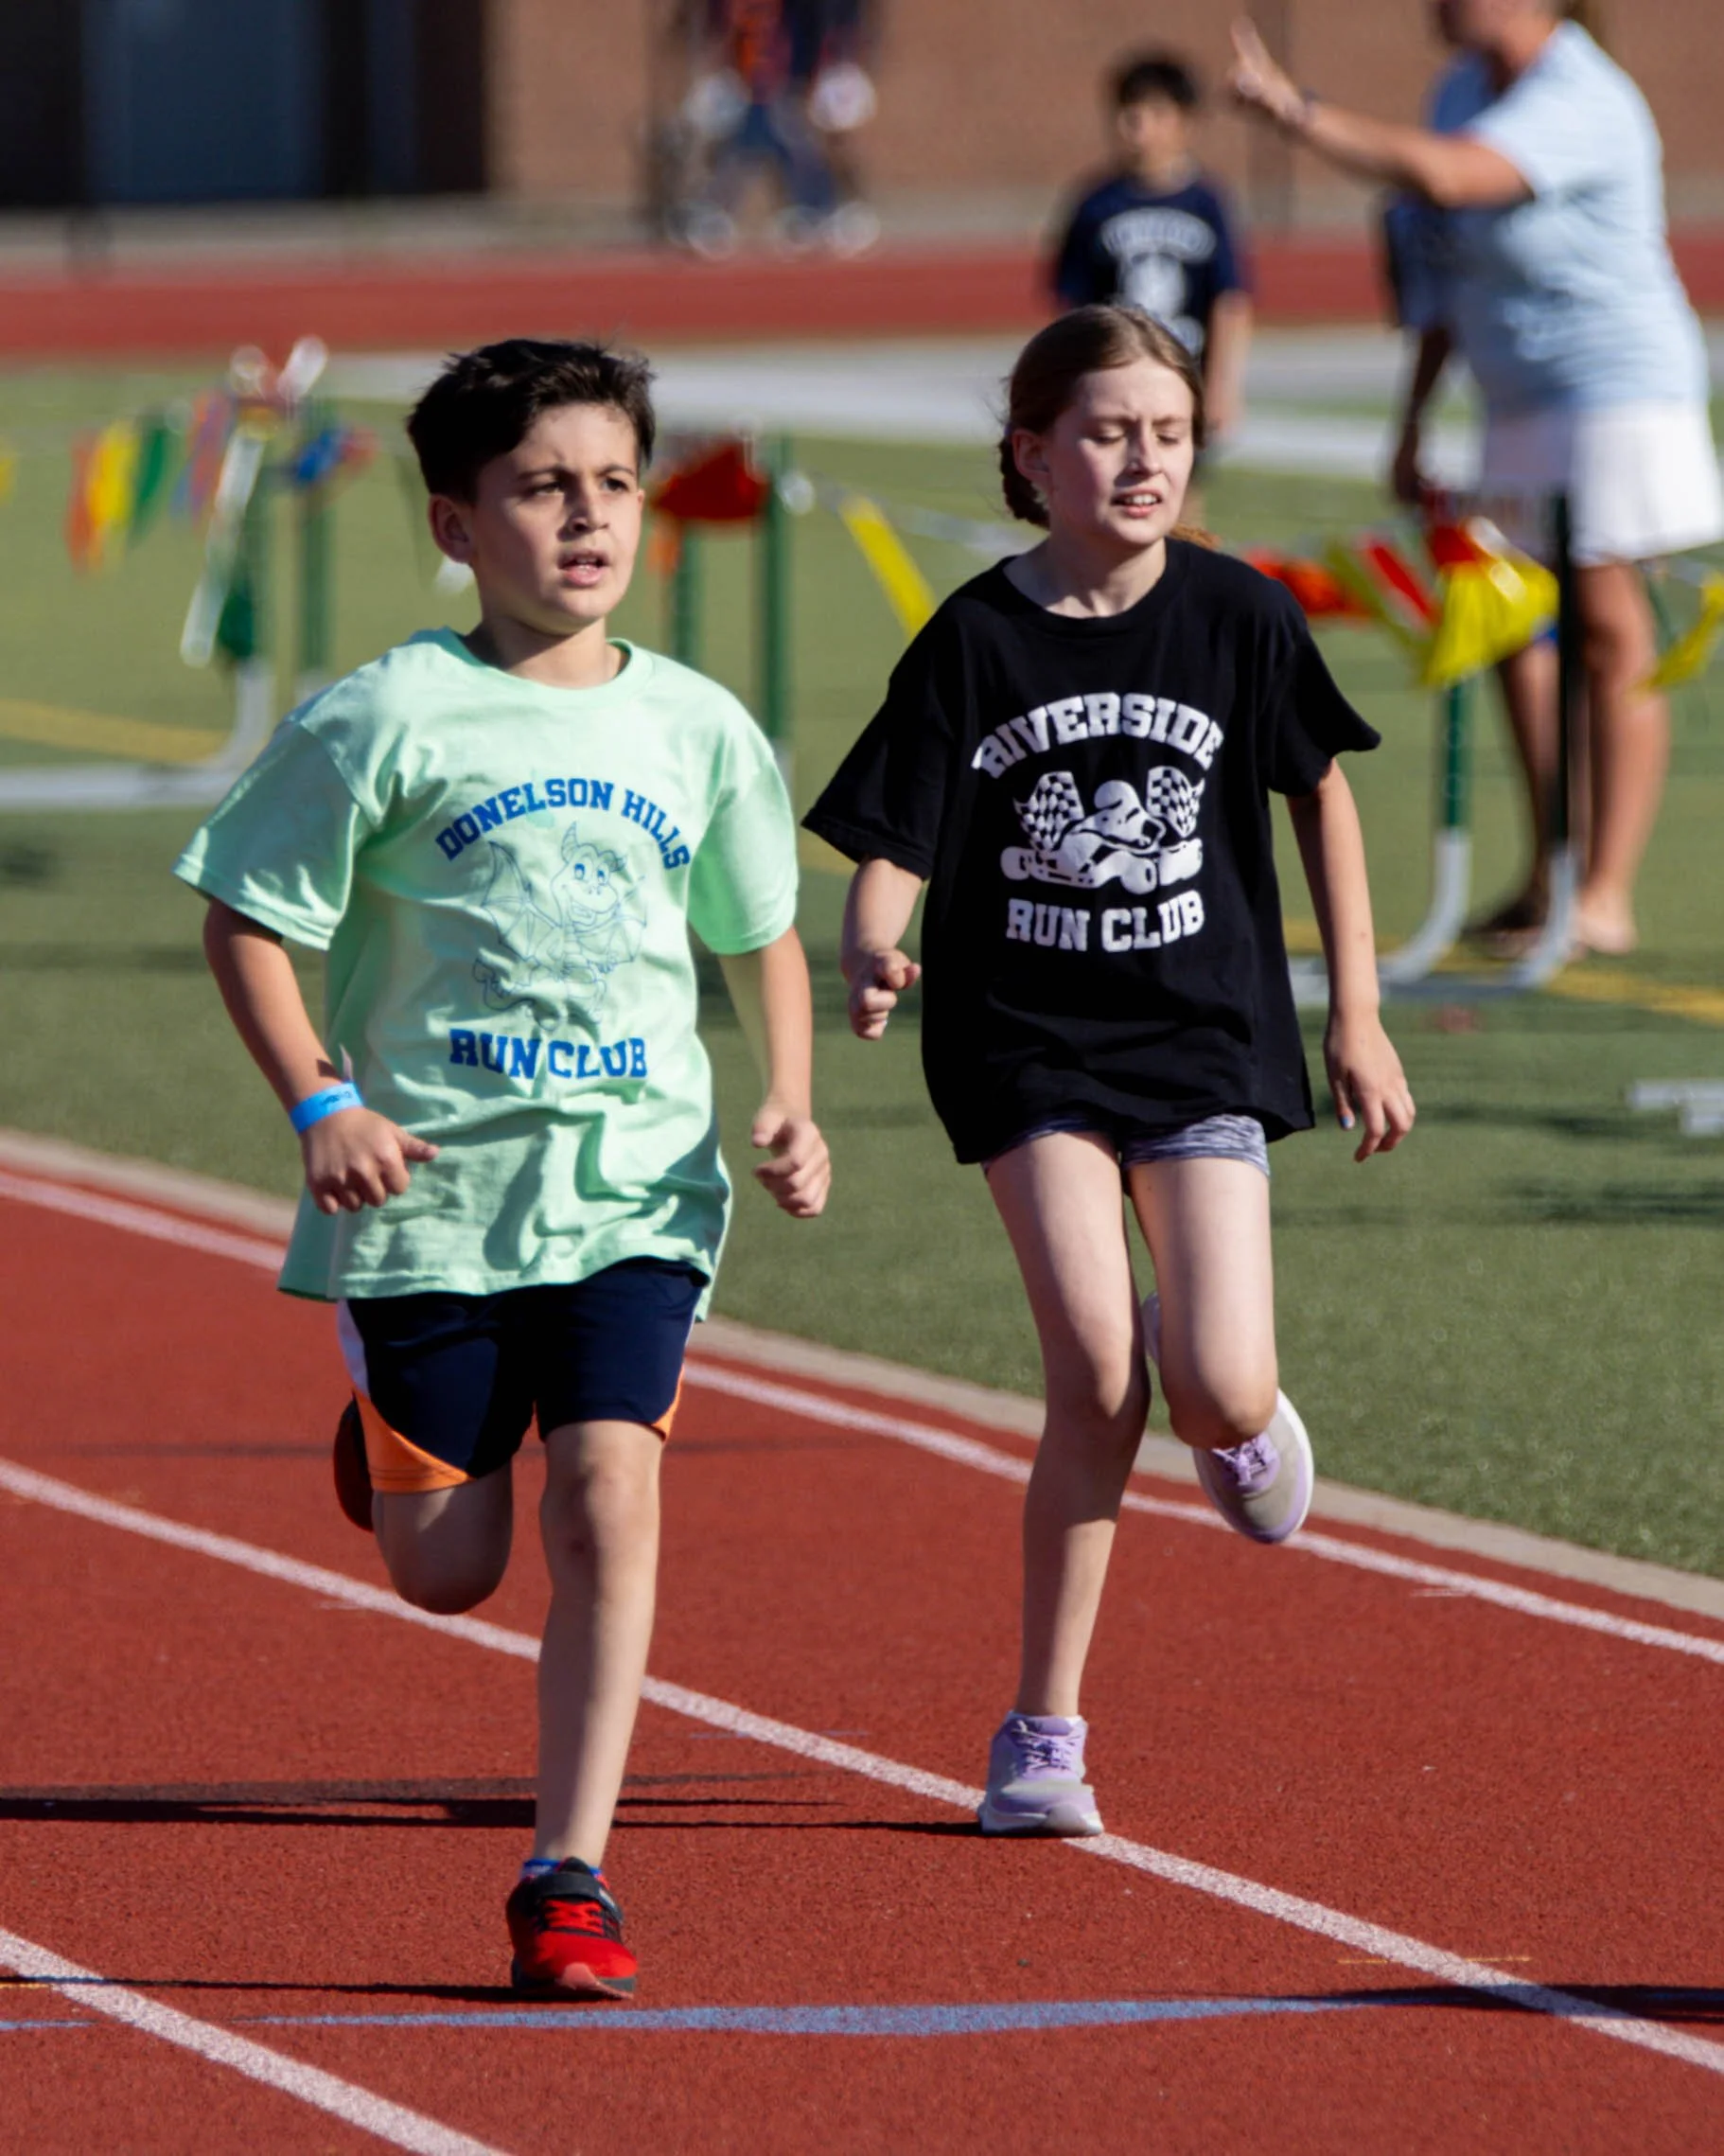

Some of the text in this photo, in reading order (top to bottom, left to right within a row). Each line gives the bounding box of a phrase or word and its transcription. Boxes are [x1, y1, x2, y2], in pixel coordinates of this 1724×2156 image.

[971, 692, 1224, 779] RIVERSIDE
[435, 778, 691, 870] DONELSON HILLS
[1006, 890, 1205, 952] RUN CLUB
[449, 1029, 647, 1079] RUN CLUB
